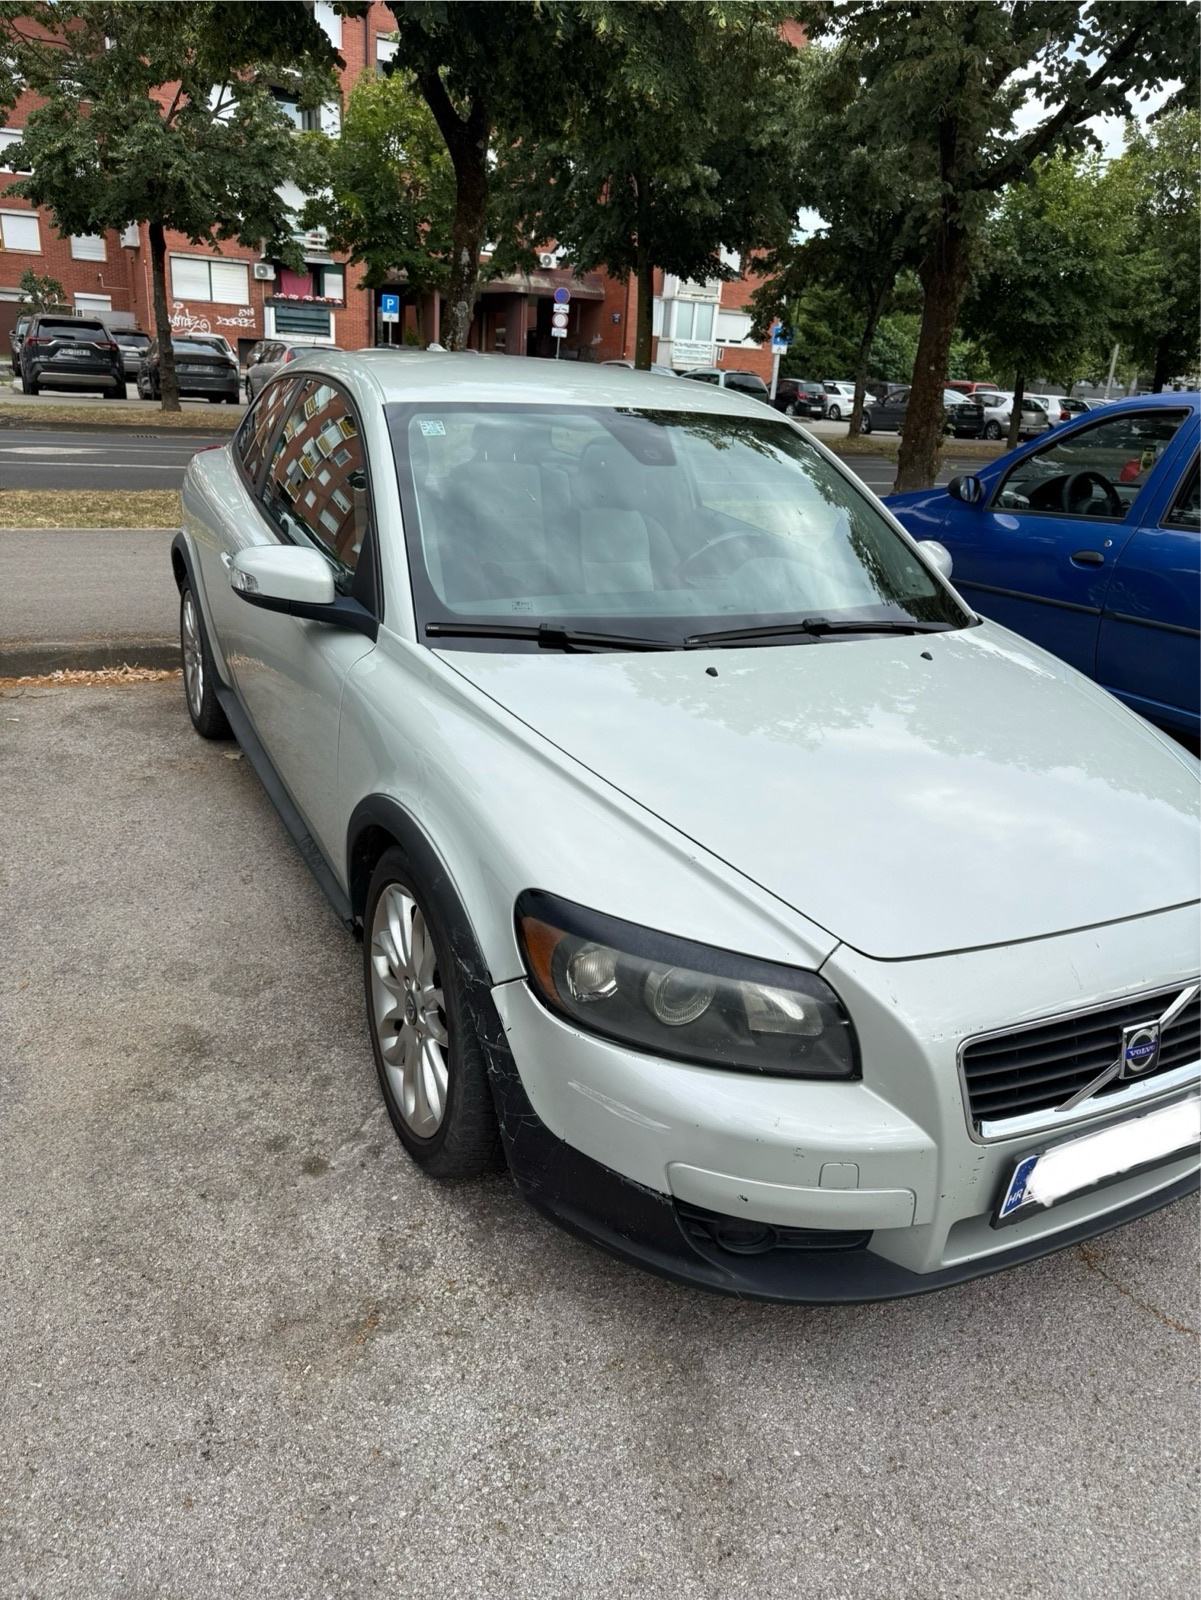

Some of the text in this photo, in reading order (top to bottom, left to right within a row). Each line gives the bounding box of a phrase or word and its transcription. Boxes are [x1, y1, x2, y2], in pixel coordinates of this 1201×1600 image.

[387, 299, 395, 310] P
[1129, 1044, 1157, 1058] VOLVO
[1006, 1188, 1023, 1207] HR
